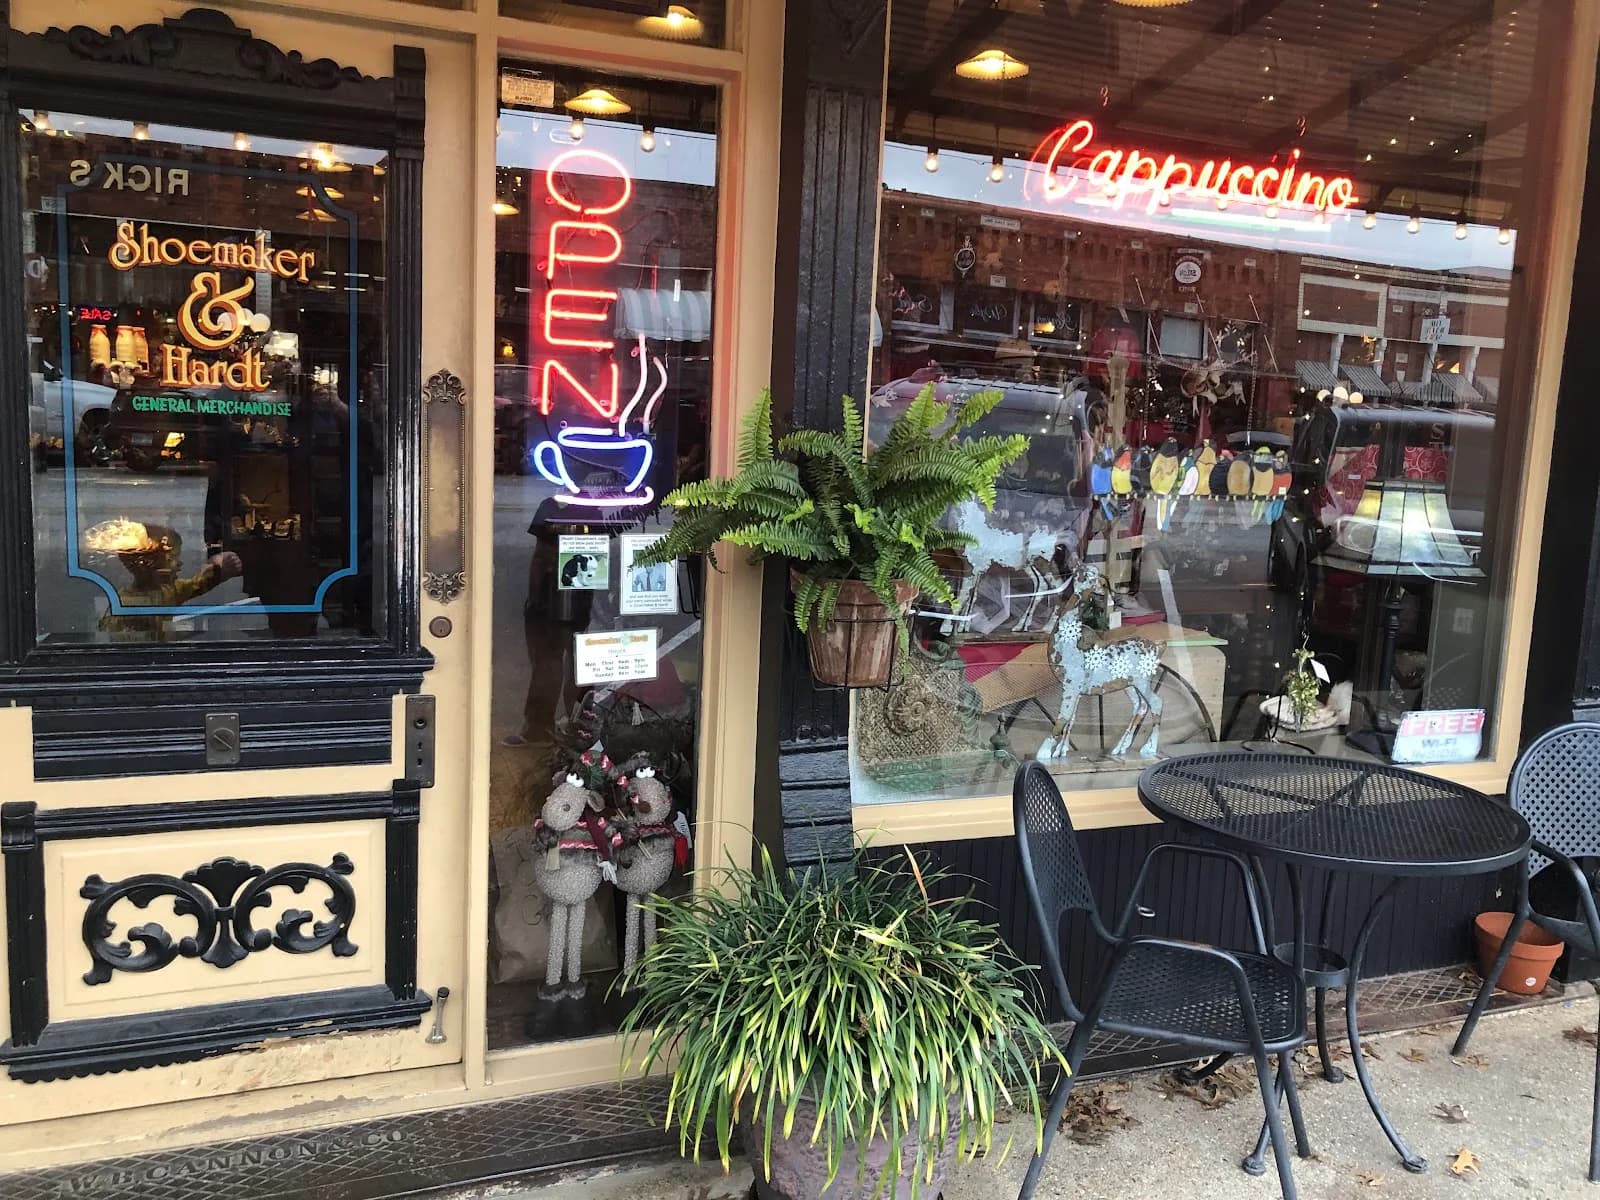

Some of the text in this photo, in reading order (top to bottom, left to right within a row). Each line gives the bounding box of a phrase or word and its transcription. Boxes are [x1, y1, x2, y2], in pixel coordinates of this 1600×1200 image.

[1043, 120, 1359, 216] Cappuccino
[108, 221, 315, 283] Shoemaker
[177, 271, 255, 350] &
[540, 149, 632, 418] OPEN
[160, 343, 270, 392] Hardt
[132, 396, 292, 416] GENERAL MERCHANDISE
[1407, 713, 1479, 736] FREE
